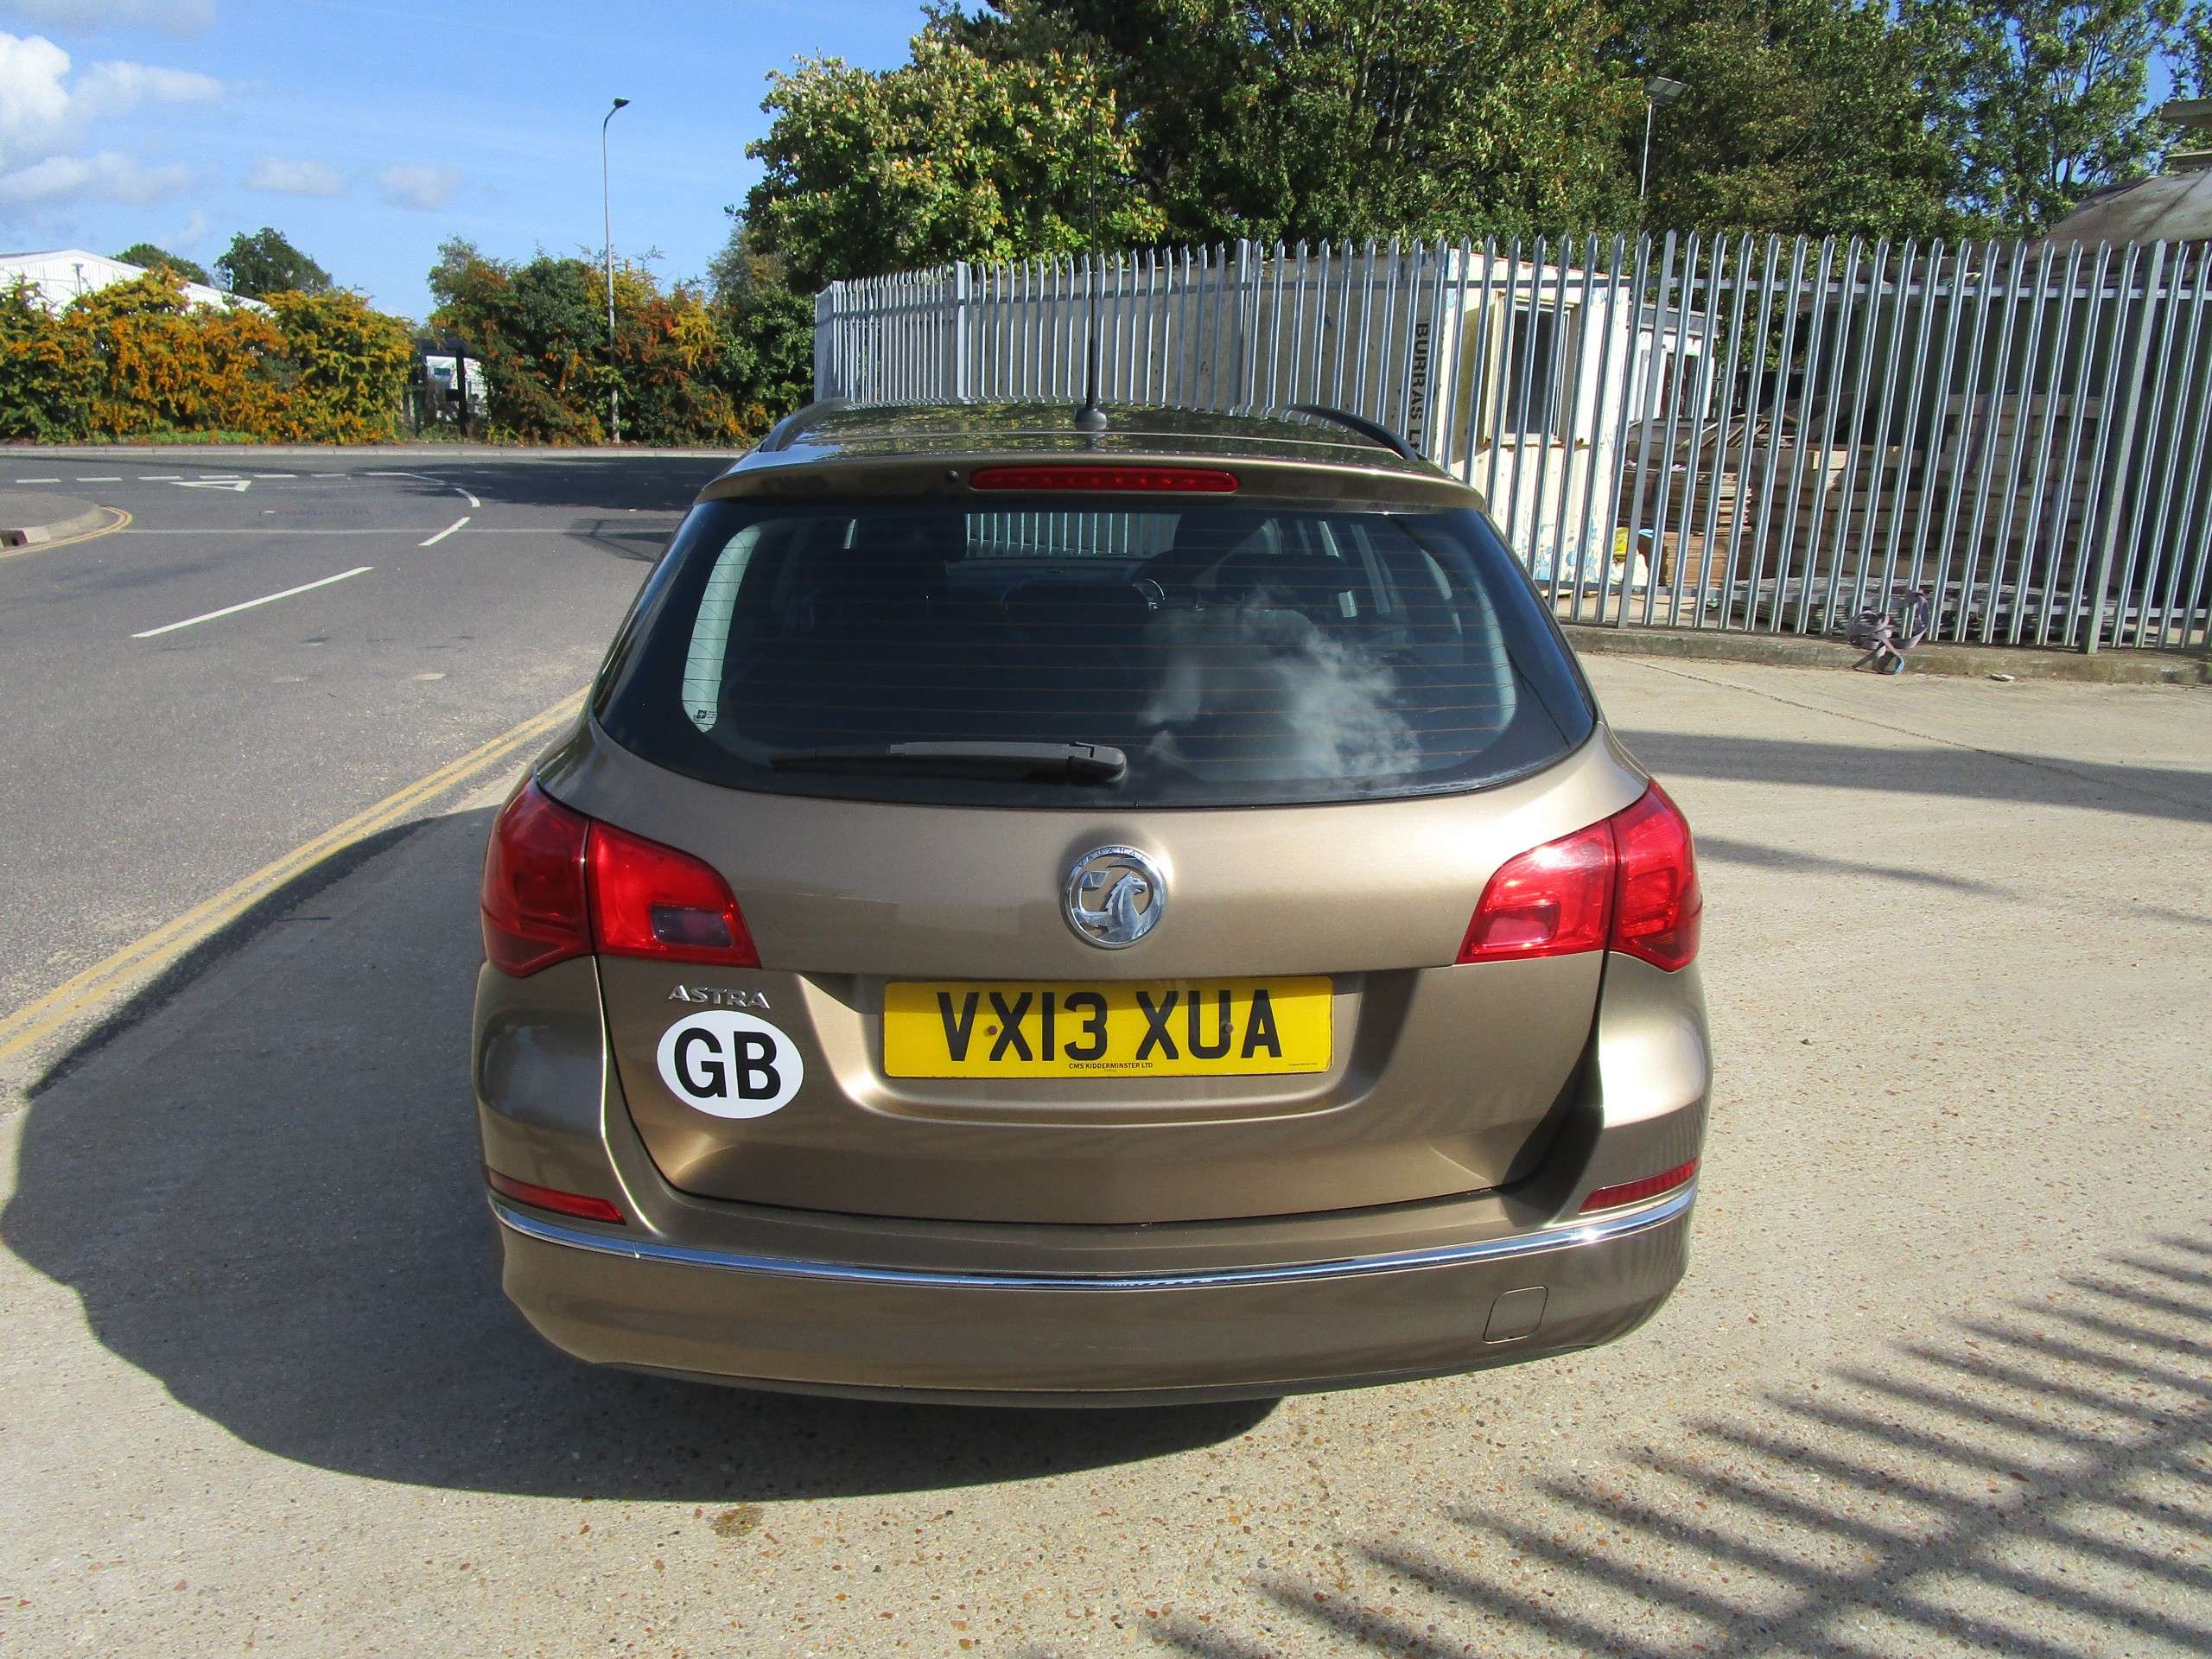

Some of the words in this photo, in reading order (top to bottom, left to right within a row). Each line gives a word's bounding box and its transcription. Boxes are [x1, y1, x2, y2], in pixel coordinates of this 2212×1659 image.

[1409, 323, 1428, 420] BURRAS
[1408, 429, 1421, 450] Lt
[1077, 846, 1149, 869] VAUXHA
[668, 984, 771, 1009] ASTRA
[937, 990, 1109, 1062] VX13
[1135, 988, 1283, 1060] XUA
[673, 1027, 781, 1100] GB
